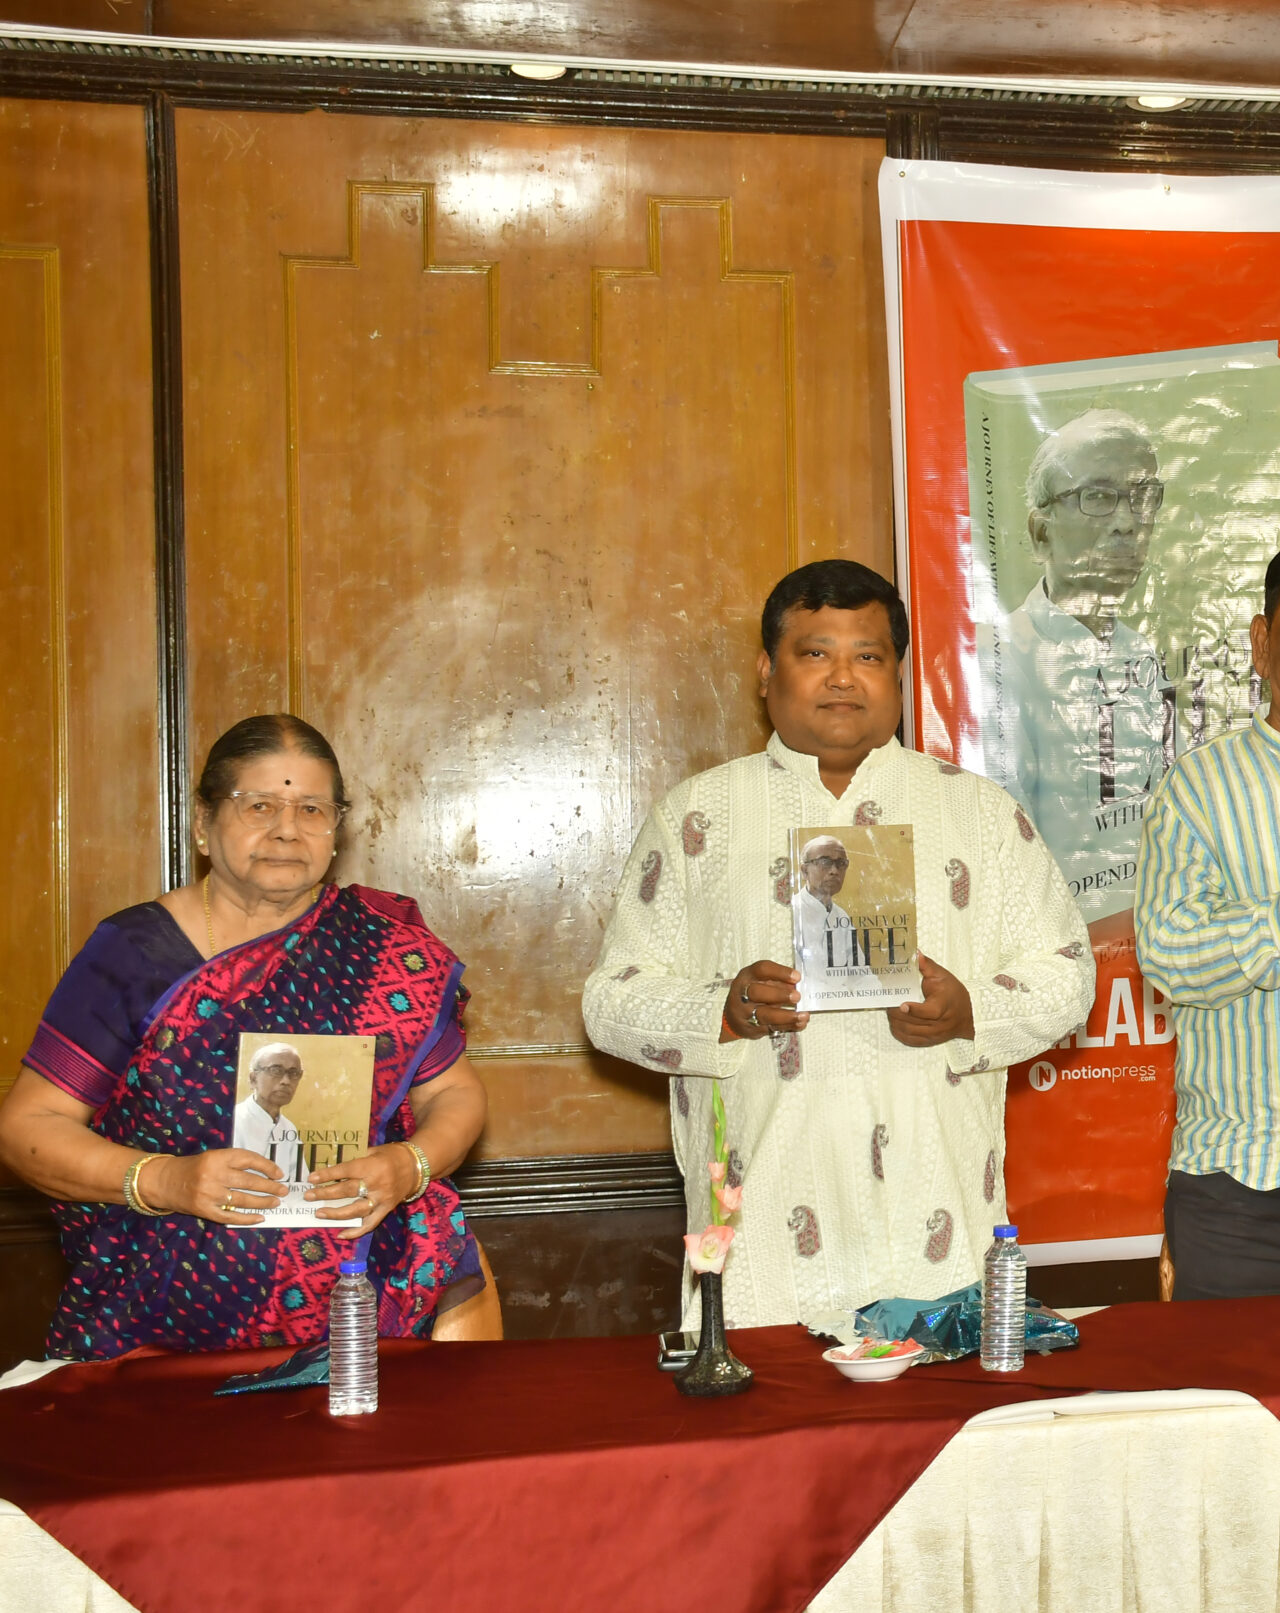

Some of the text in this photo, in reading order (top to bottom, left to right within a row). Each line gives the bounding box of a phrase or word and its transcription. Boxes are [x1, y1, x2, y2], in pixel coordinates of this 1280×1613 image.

[981, 425, 994, 500] JOURNEY
[1068, 862, 1137, 897] OPEND
[833, 915, 889, 929] JOURNEY
[892, 914, 910, 926] OF
[825, 927, 910, 968] LIFE
[826, 969, 846, 977] WITH
[846, 968, 870, 977] DIVINE
[856, 988, 894, 998] KISHORE
[894, 987, 911, 996] ROY
[1061, 1065, 1156, 1083] notionpress
[279, 1130, 338, 1142] JOURNEY
[344, 1130, 363, 1142] OF
[296, 1207, 317, 1215] KISH
